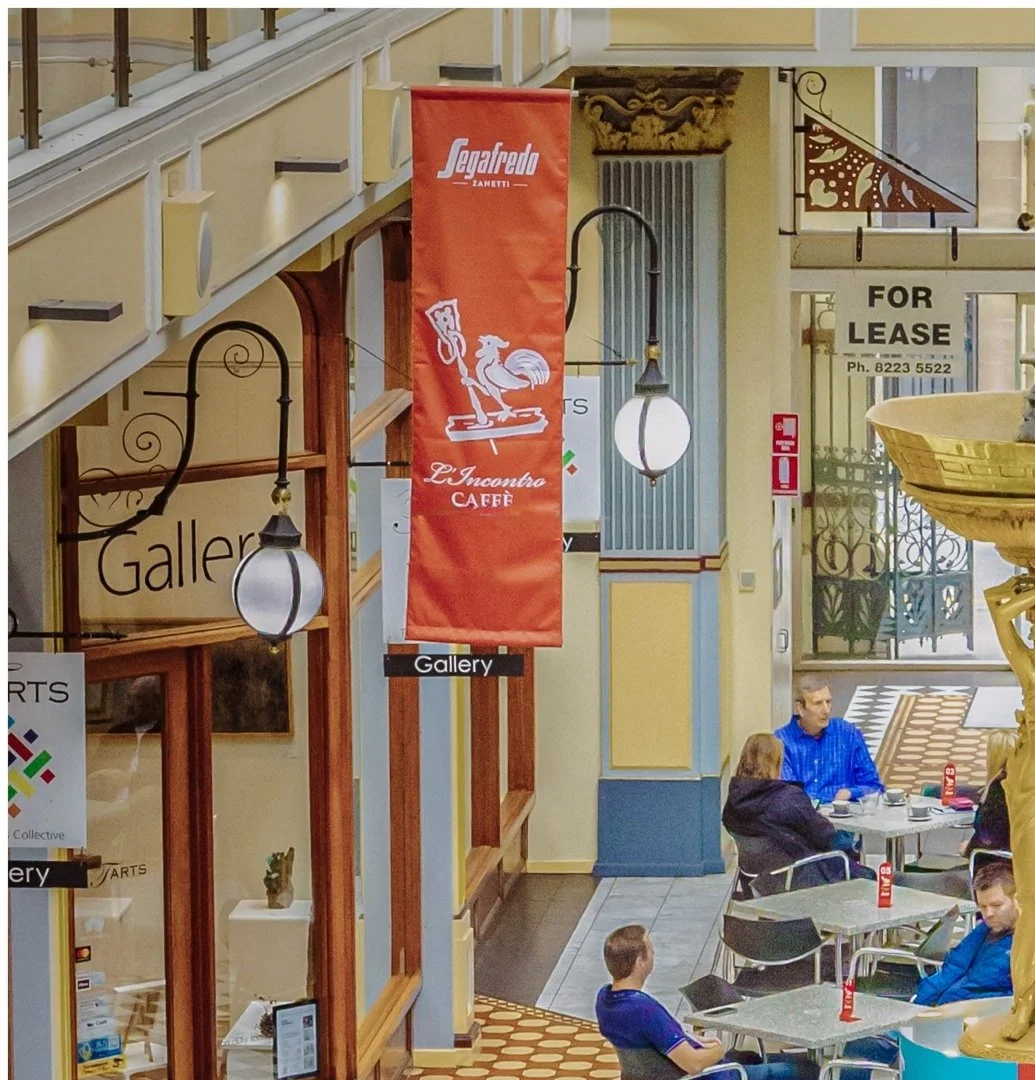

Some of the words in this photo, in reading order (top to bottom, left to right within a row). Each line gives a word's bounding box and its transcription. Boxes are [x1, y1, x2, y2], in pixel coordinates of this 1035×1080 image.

[436, 138, 540, 180] Segafredo
[472, 180, 510, 188] ZANETTI
[868, 285, 933, 309] FOR
[848, 321, 951, 346] LEASE
[847, 361, 870, 373] Ph.
[874, 362, 911, 374] 8223
[915, 362, 952, 375] 5522
[424, 462, 547, 489] L'Incontro
[97, 518, 257, 597] Galler
[414, 655, 493, 677] Gallery
[13, 829, 65, 841] Collective
